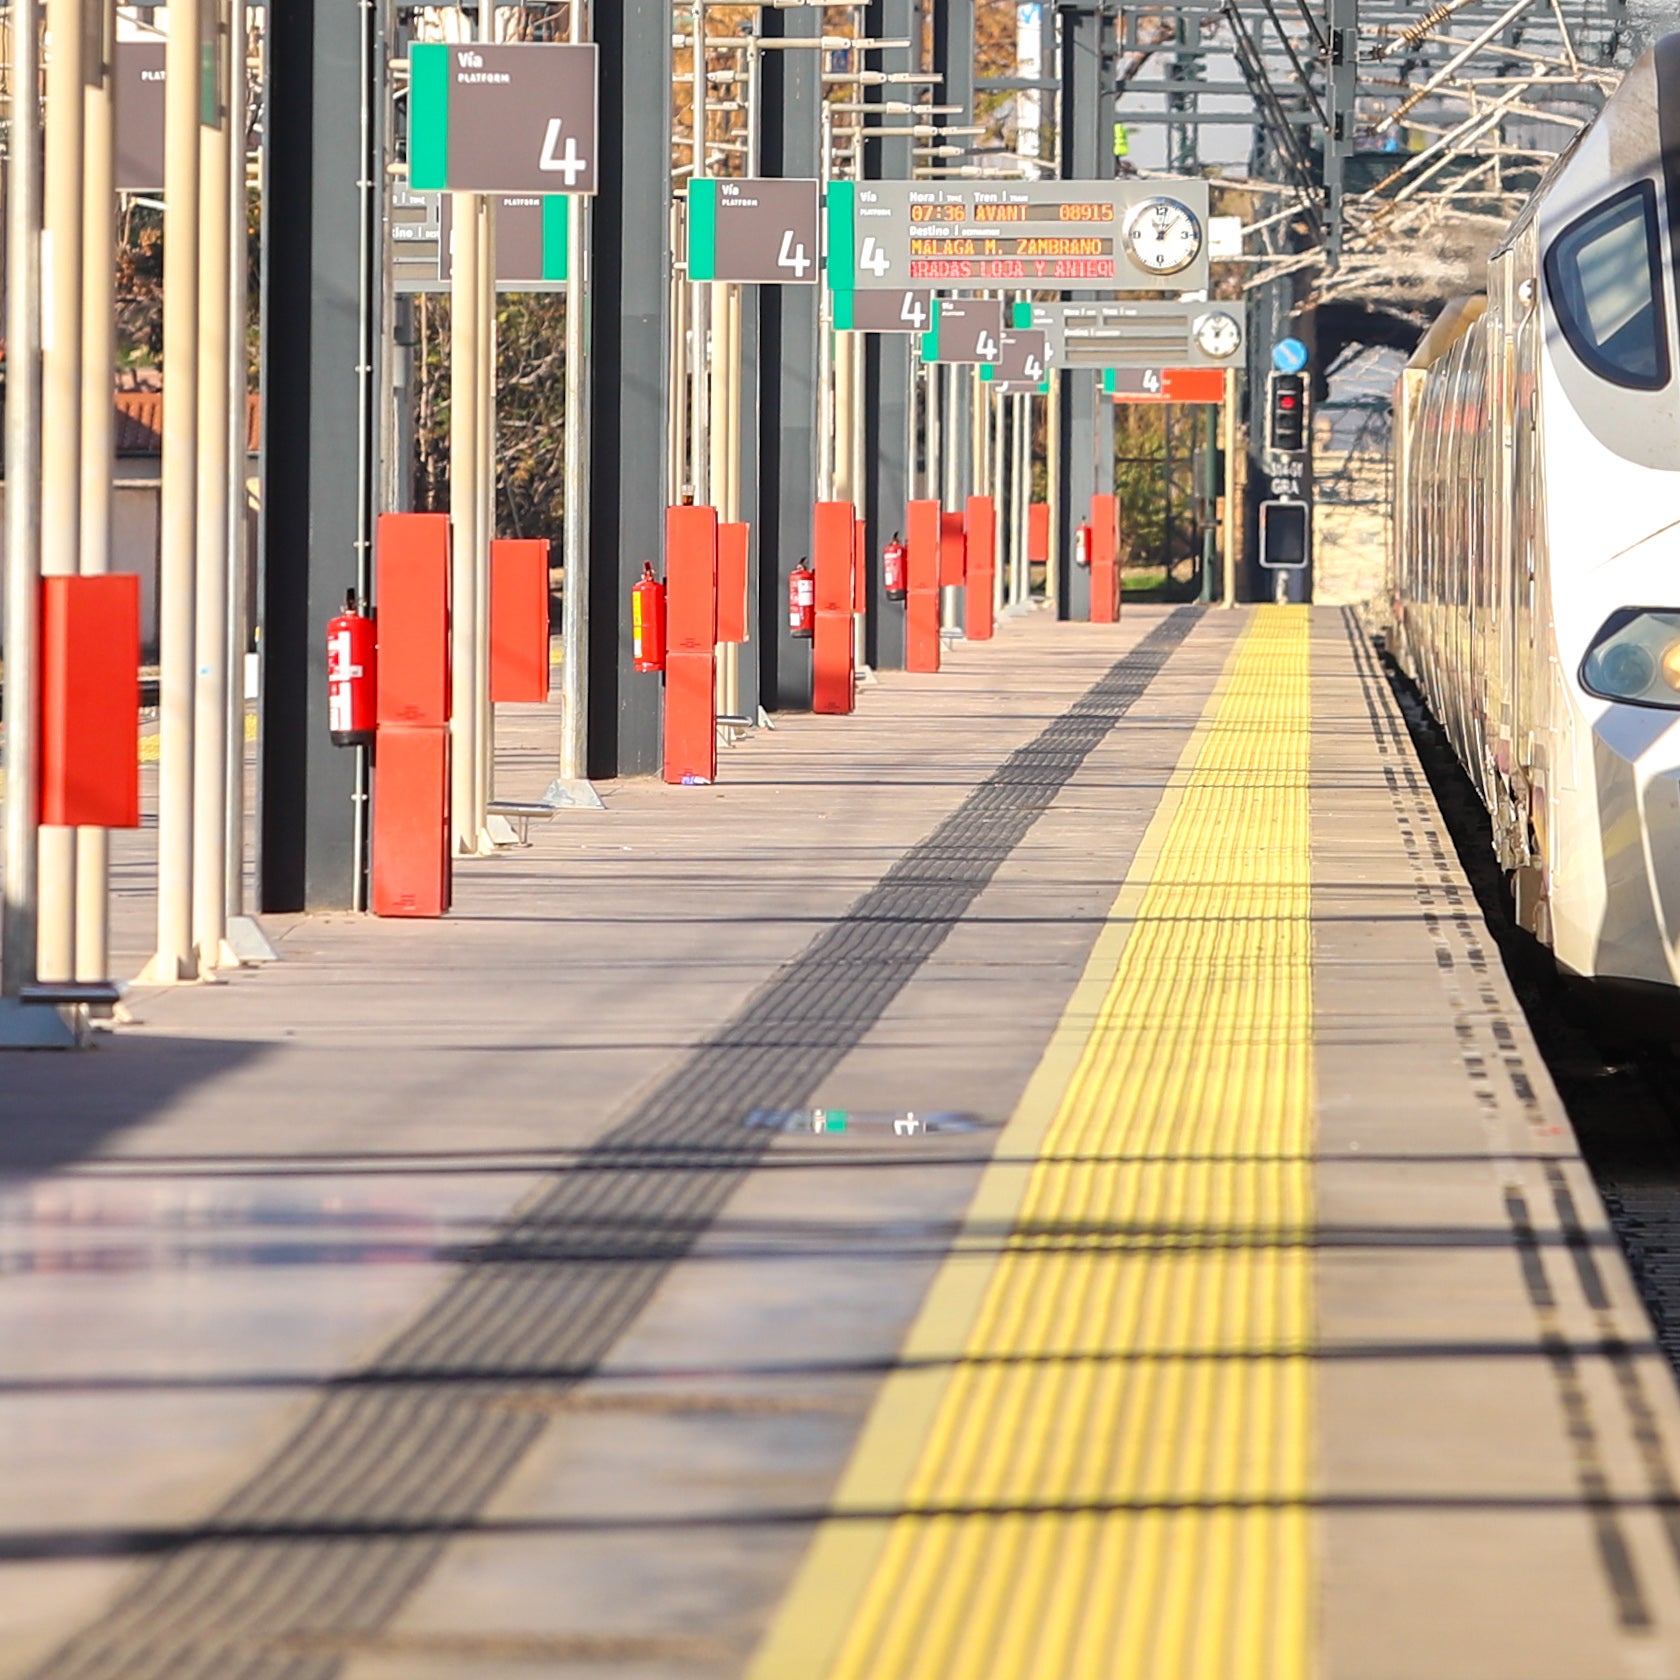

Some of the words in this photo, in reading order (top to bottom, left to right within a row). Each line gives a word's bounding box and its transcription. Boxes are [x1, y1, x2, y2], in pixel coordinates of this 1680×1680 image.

[457, 50, 483, 69] Vía
[457, 72, 510, 84] PLATFORM
[539, 117, 586, 186] 4
[721, 183, 740, 196] Vía
[909, 192, 936, 202] Hora
[973, 192, 998, 202] Tren
[912, 205, 965, 221] 07:36
[975, 205, 1028, 221] AVANT
[1059, 205, 1114, 221] 08915
[909, 225, 950, 237] Destino
[777, 230, 811, 278] 4
[1016, 239, 1103, 255] ZAMBRANO
[859, 237, 891, 277] 4
[1034, 261, 1046, 277] Y
[900, 291, 927, 328] 4
[975, 330, 998, 361] 4
[1024, 354, 1043, 381] 4
[1142, 369, 1159, 392] 4
